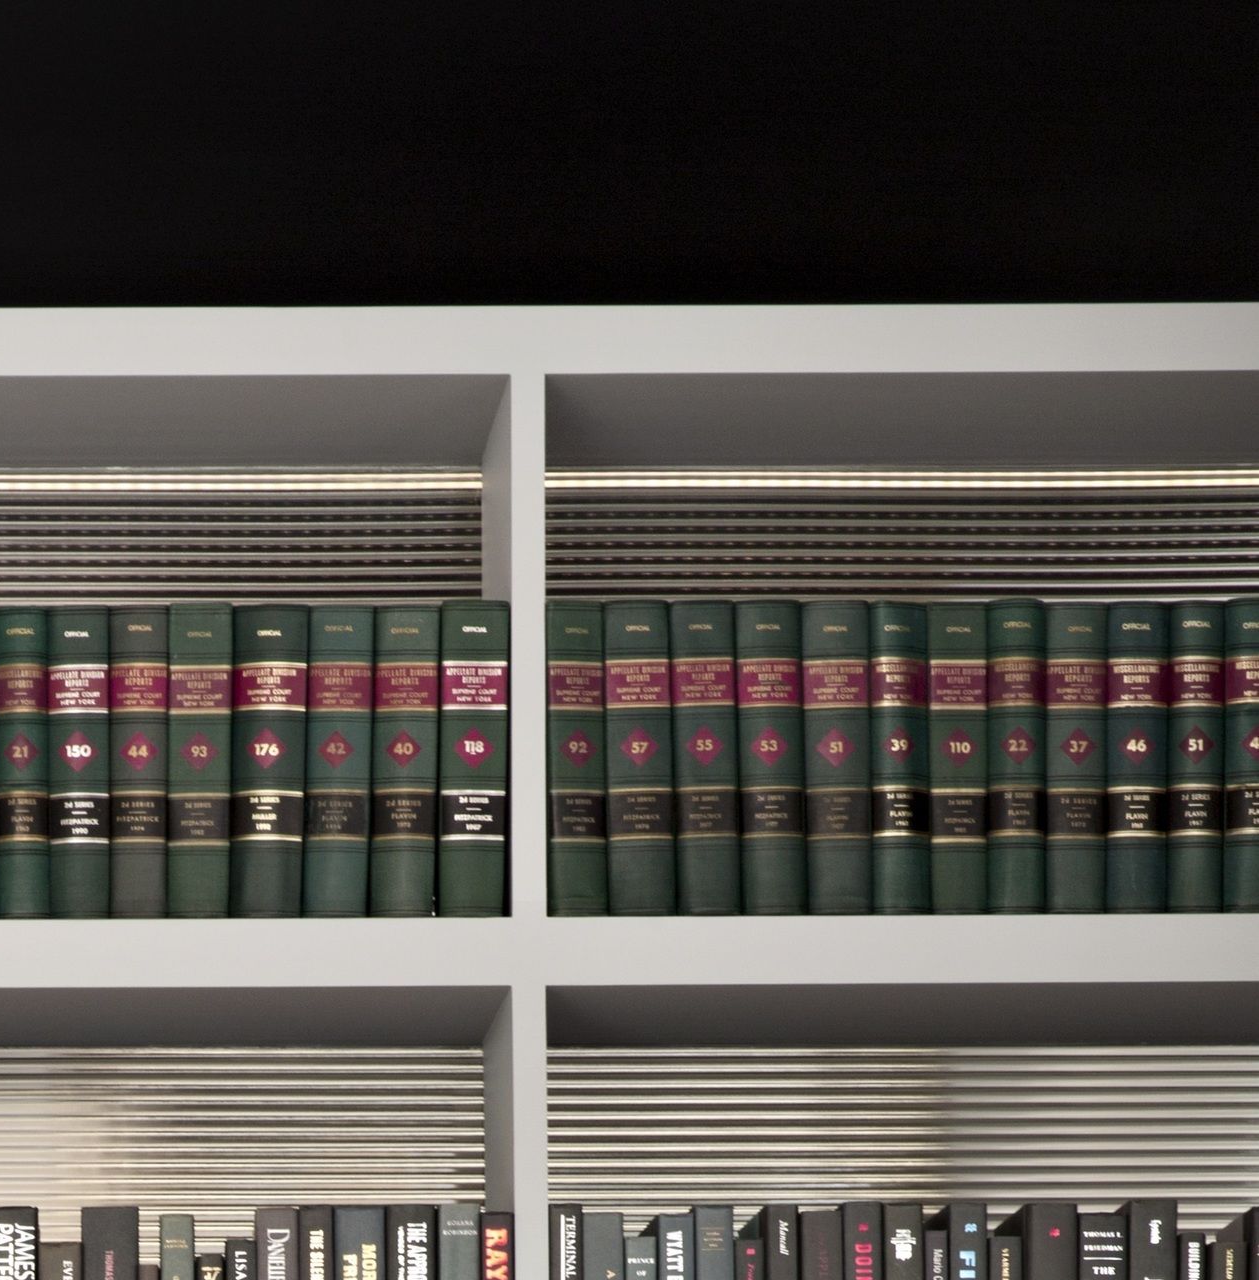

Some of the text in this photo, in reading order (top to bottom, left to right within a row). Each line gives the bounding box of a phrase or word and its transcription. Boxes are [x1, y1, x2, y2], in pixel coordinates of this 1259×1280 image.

[254, 744, 279, 756] 176
[394, 743, 413, 755] 40
[464, 741, 484, 754] 118
[696, 740, 713, 751] 55
[761, 740, 778, 752] 53
[891, 739, 908, 751] 39
[950, 742, 971, 753] 110
[1009, 740, 1028, 751] 22
[1070, 741, 1087, 752] 37
[1127, 739, 1146, 752] 46
[12, 746, 28, 758] 21
[65, 745, 91, 758] 150
[128, 745, 147, 758] 44
[191, 746, 207, 758] 93
[14, 1223, 35, 1280] JAMES
[565, 1216, 576, 1278] TERMINAL
[235, 1251, 247, 1280] LISA
